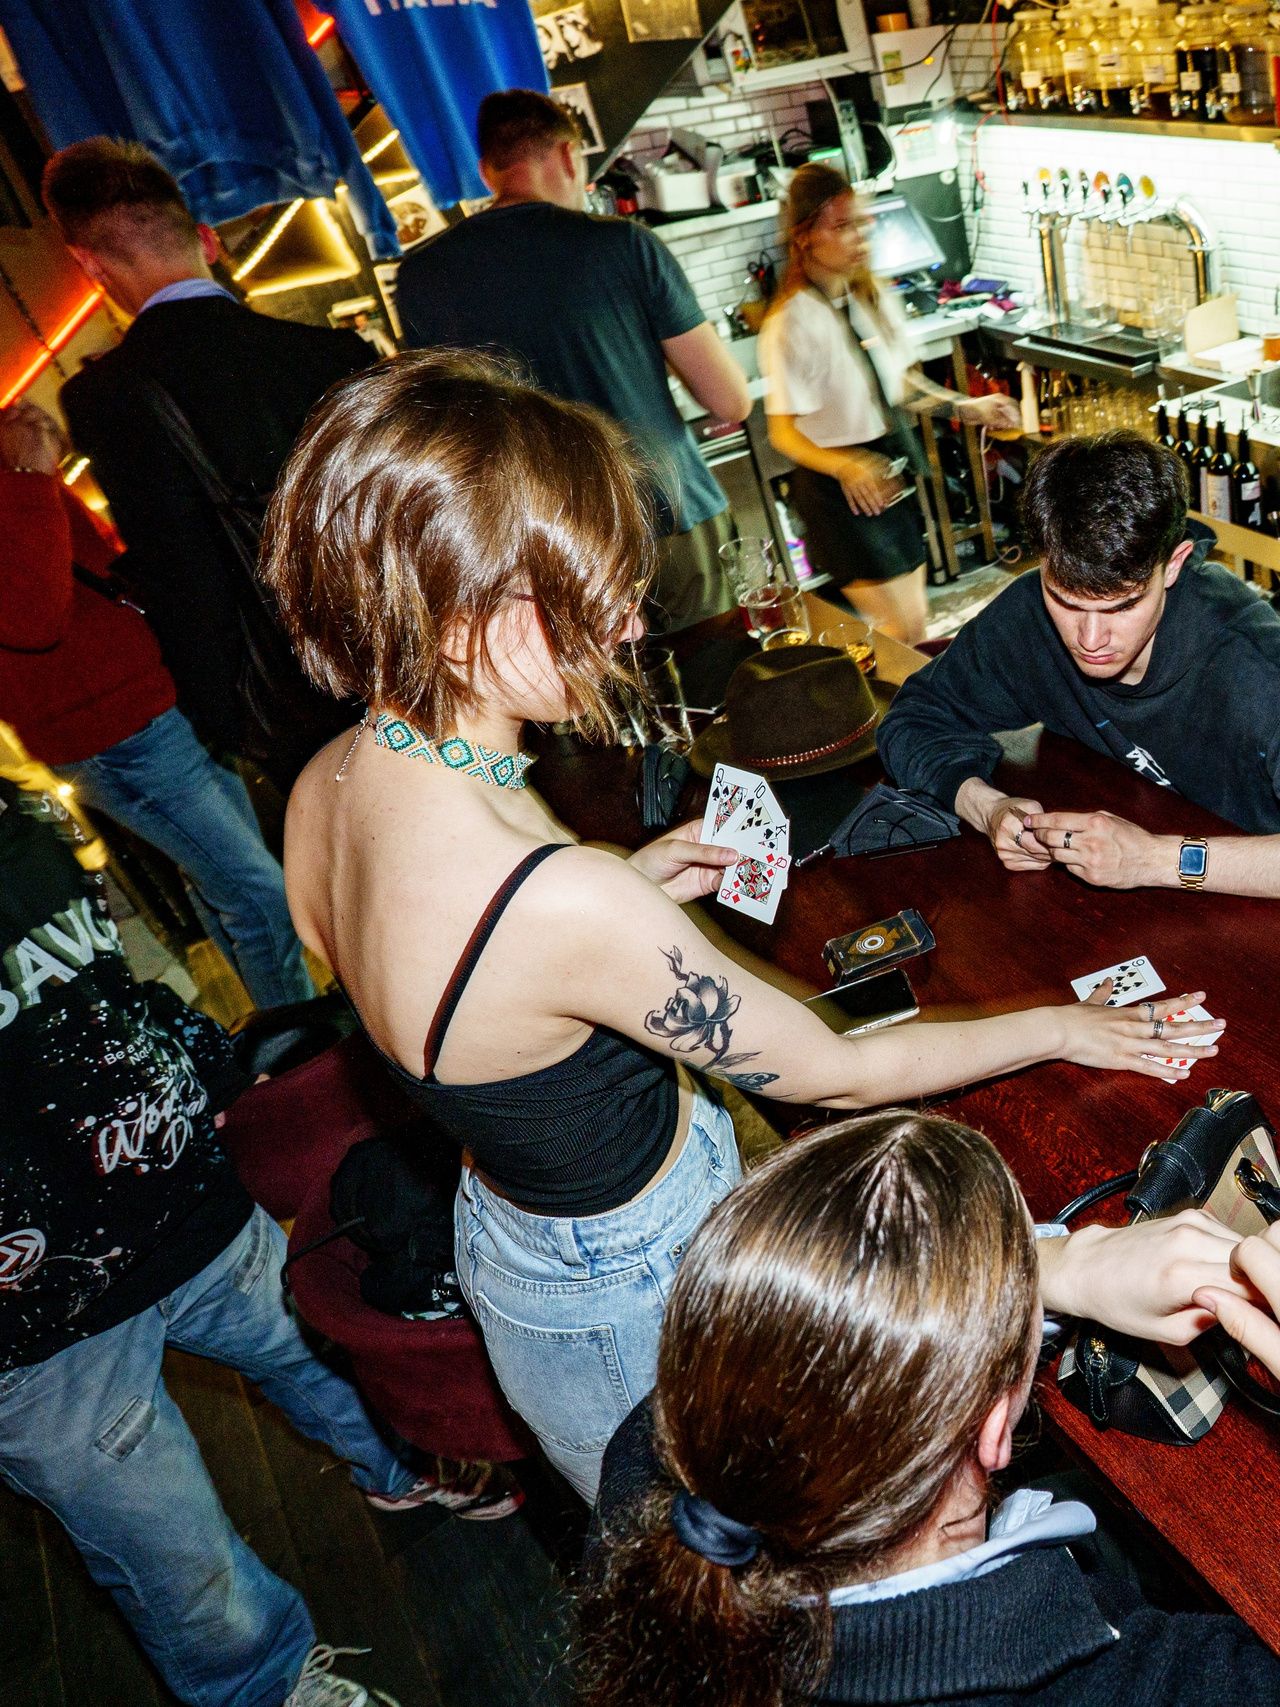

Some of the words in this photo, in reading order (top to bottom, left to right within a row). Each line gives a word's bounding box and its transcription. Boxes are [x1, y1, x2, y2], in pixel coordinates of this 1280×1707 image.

[715, 767, 725, 787] Q
[753, 781, 767, 800] 10
[775, 823, 787, 838] K
[773, 856, 788, 869] Q
[720, 888, 733, 900] Q
[1132, 958, 1146, 968] 9
[104, 1049, 126, 1066] Be
[126, 1044, 136, 1054] a
